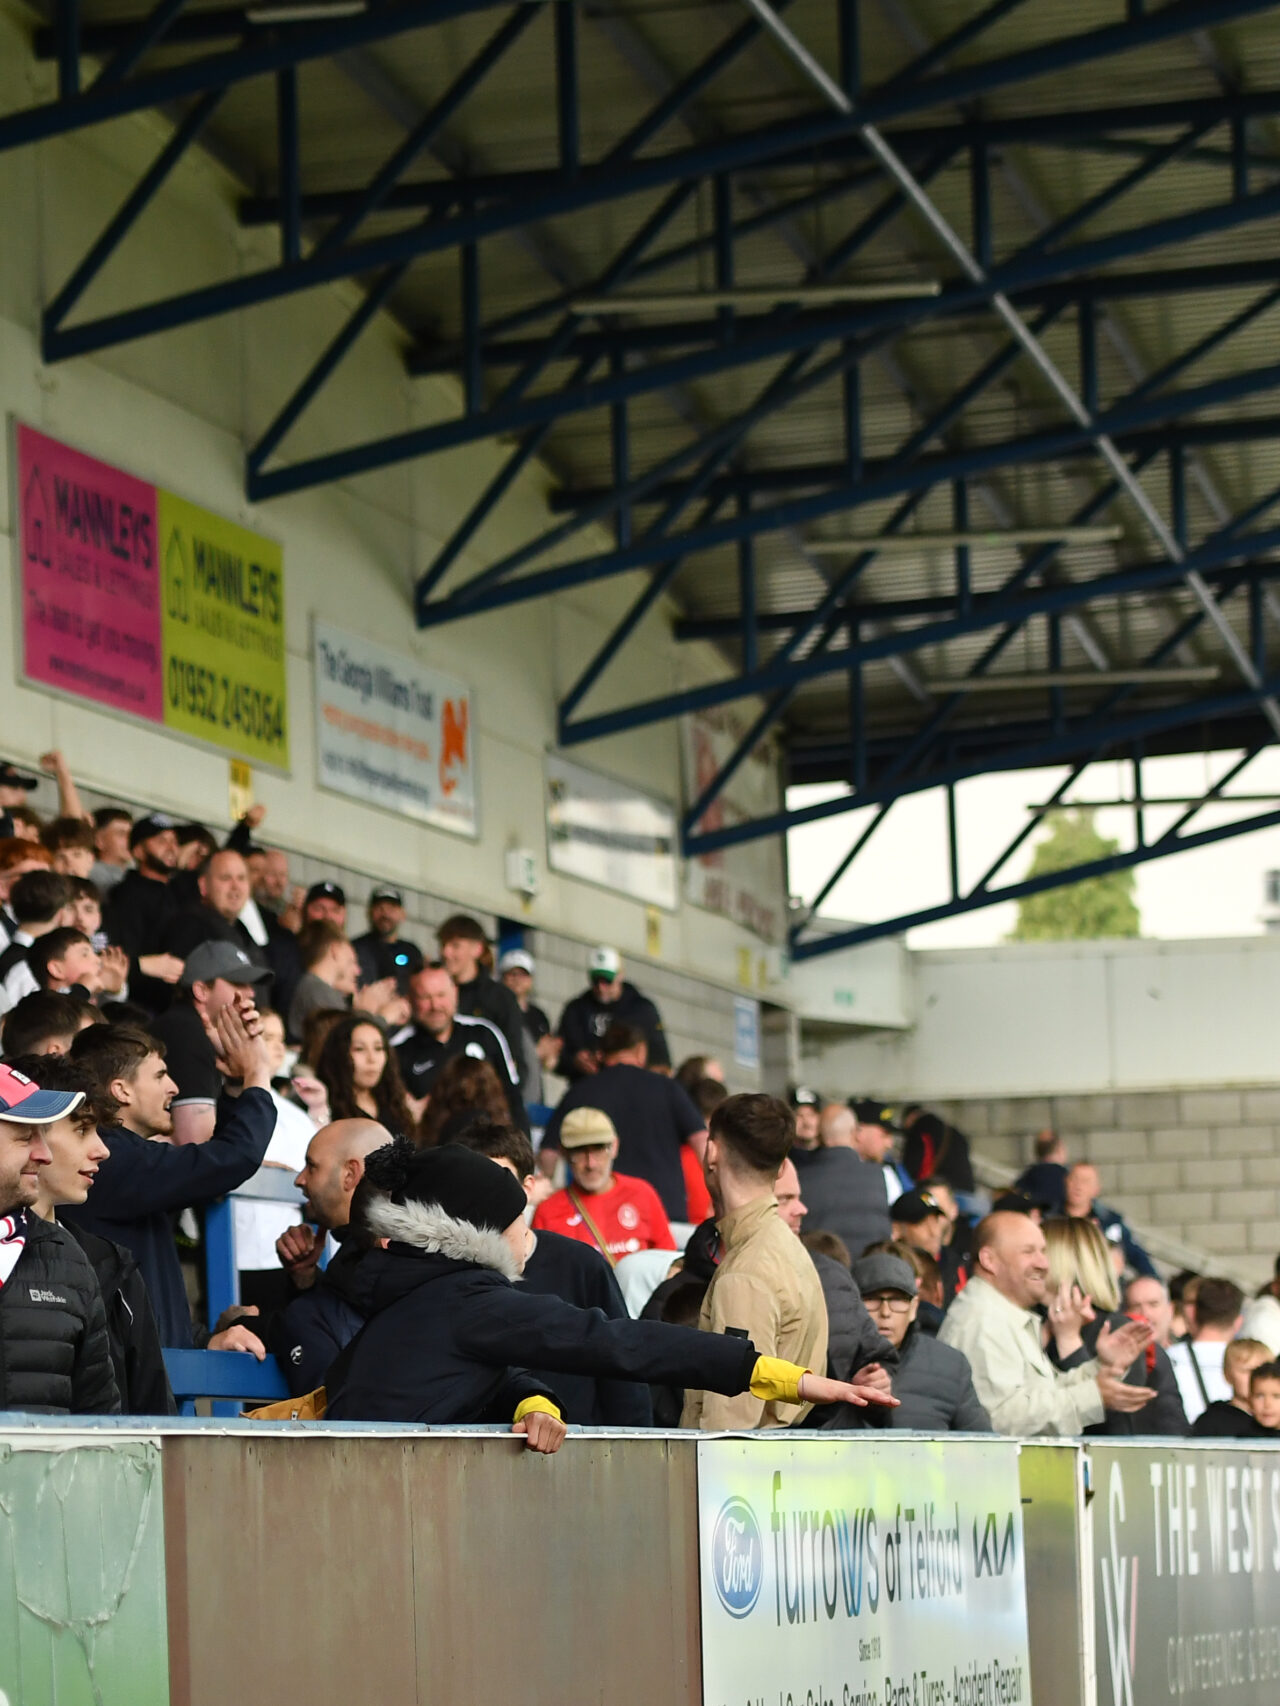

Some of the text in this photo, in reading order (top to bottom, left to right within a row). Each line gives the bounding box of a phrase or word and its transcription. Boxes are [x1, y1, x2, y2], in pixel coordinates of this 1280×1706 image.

[723, 1516, 754, 1594] Ford
[885, 1503, 901, 1603] of
[904, 1501, 963, 1600] Telford
[1150, 1461, 1200, 1577] THE
[1205, 1466, 1263, 1574] WEST
[953, 1659, 992, 1704] Accident
[994, 1655, 1022, 1705] Repair
